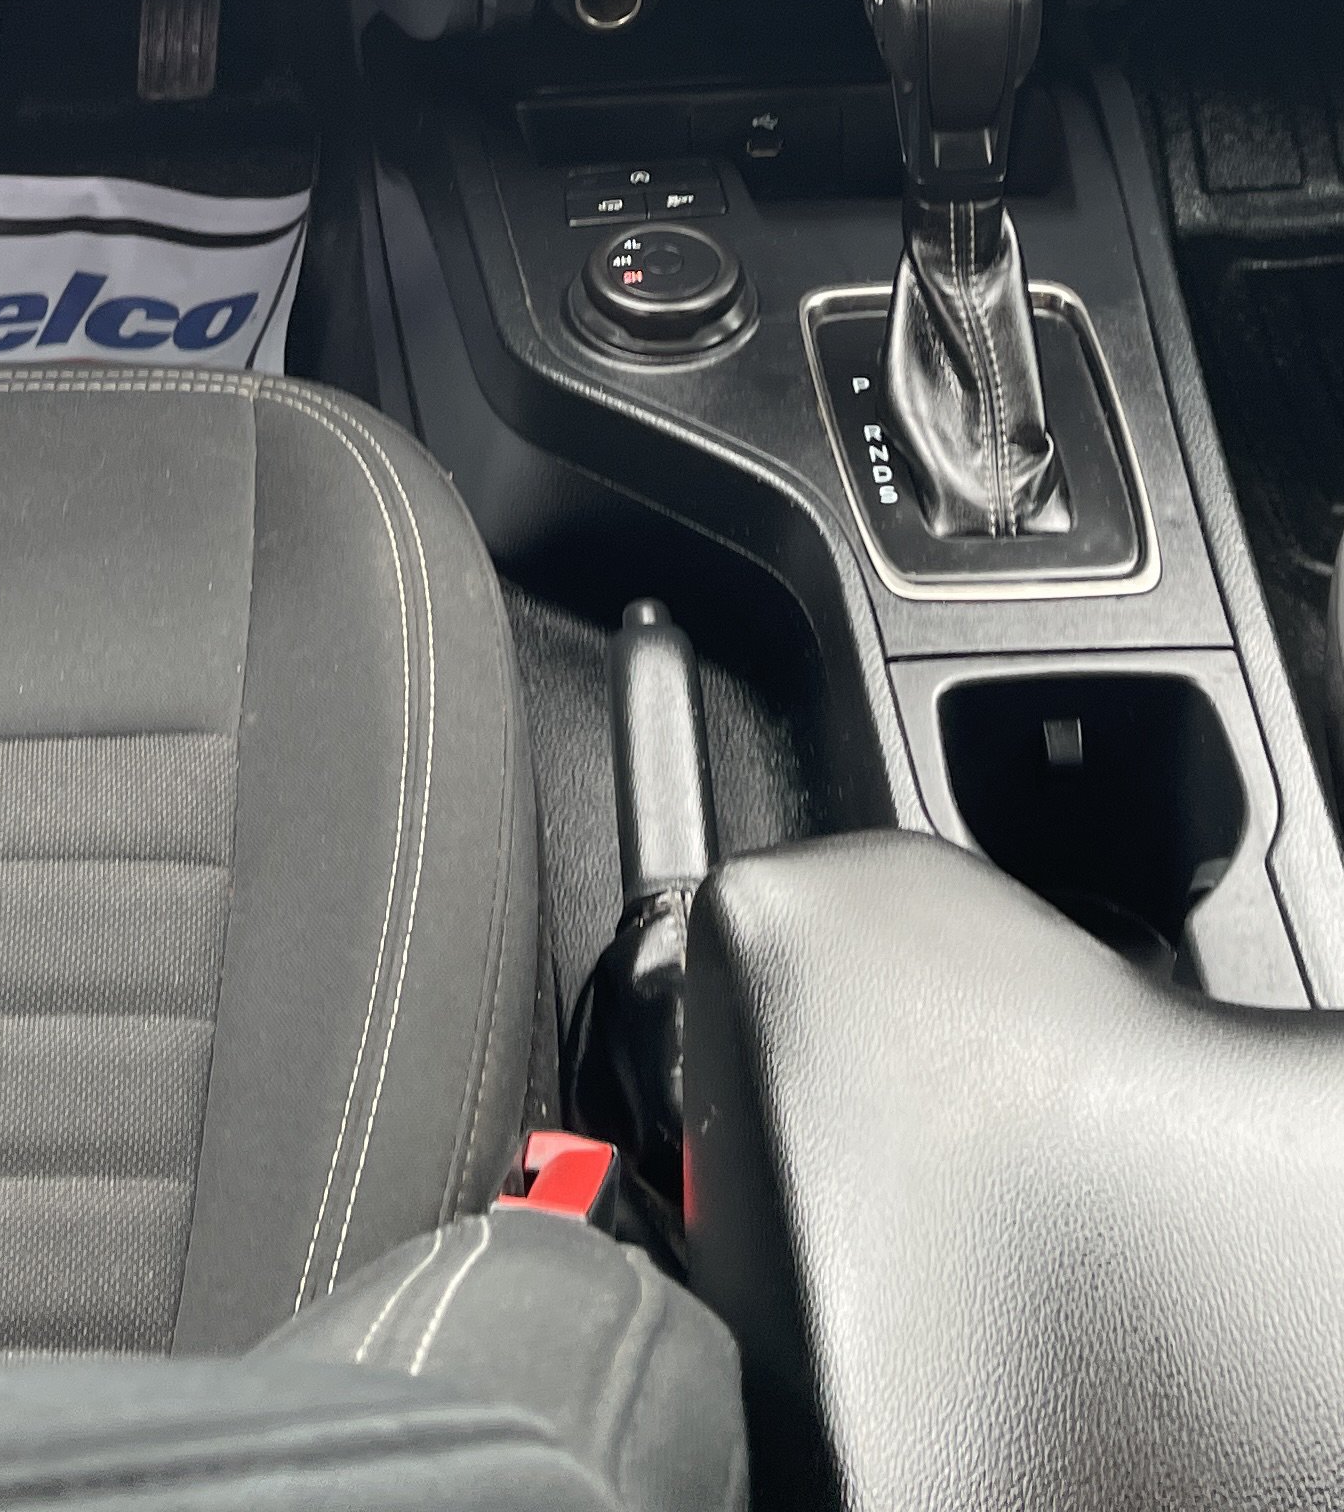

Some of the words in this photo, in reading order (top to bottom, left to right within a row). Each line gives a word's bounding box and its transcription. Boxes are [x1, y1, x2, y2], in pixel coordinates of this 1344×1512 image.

[852, 377, 870, 394] P
[863, 424, 882, 442] R
[869, 444, 889, 463] N
[872, 465, 893, 483] D
[879, 485, 898, 504] S
